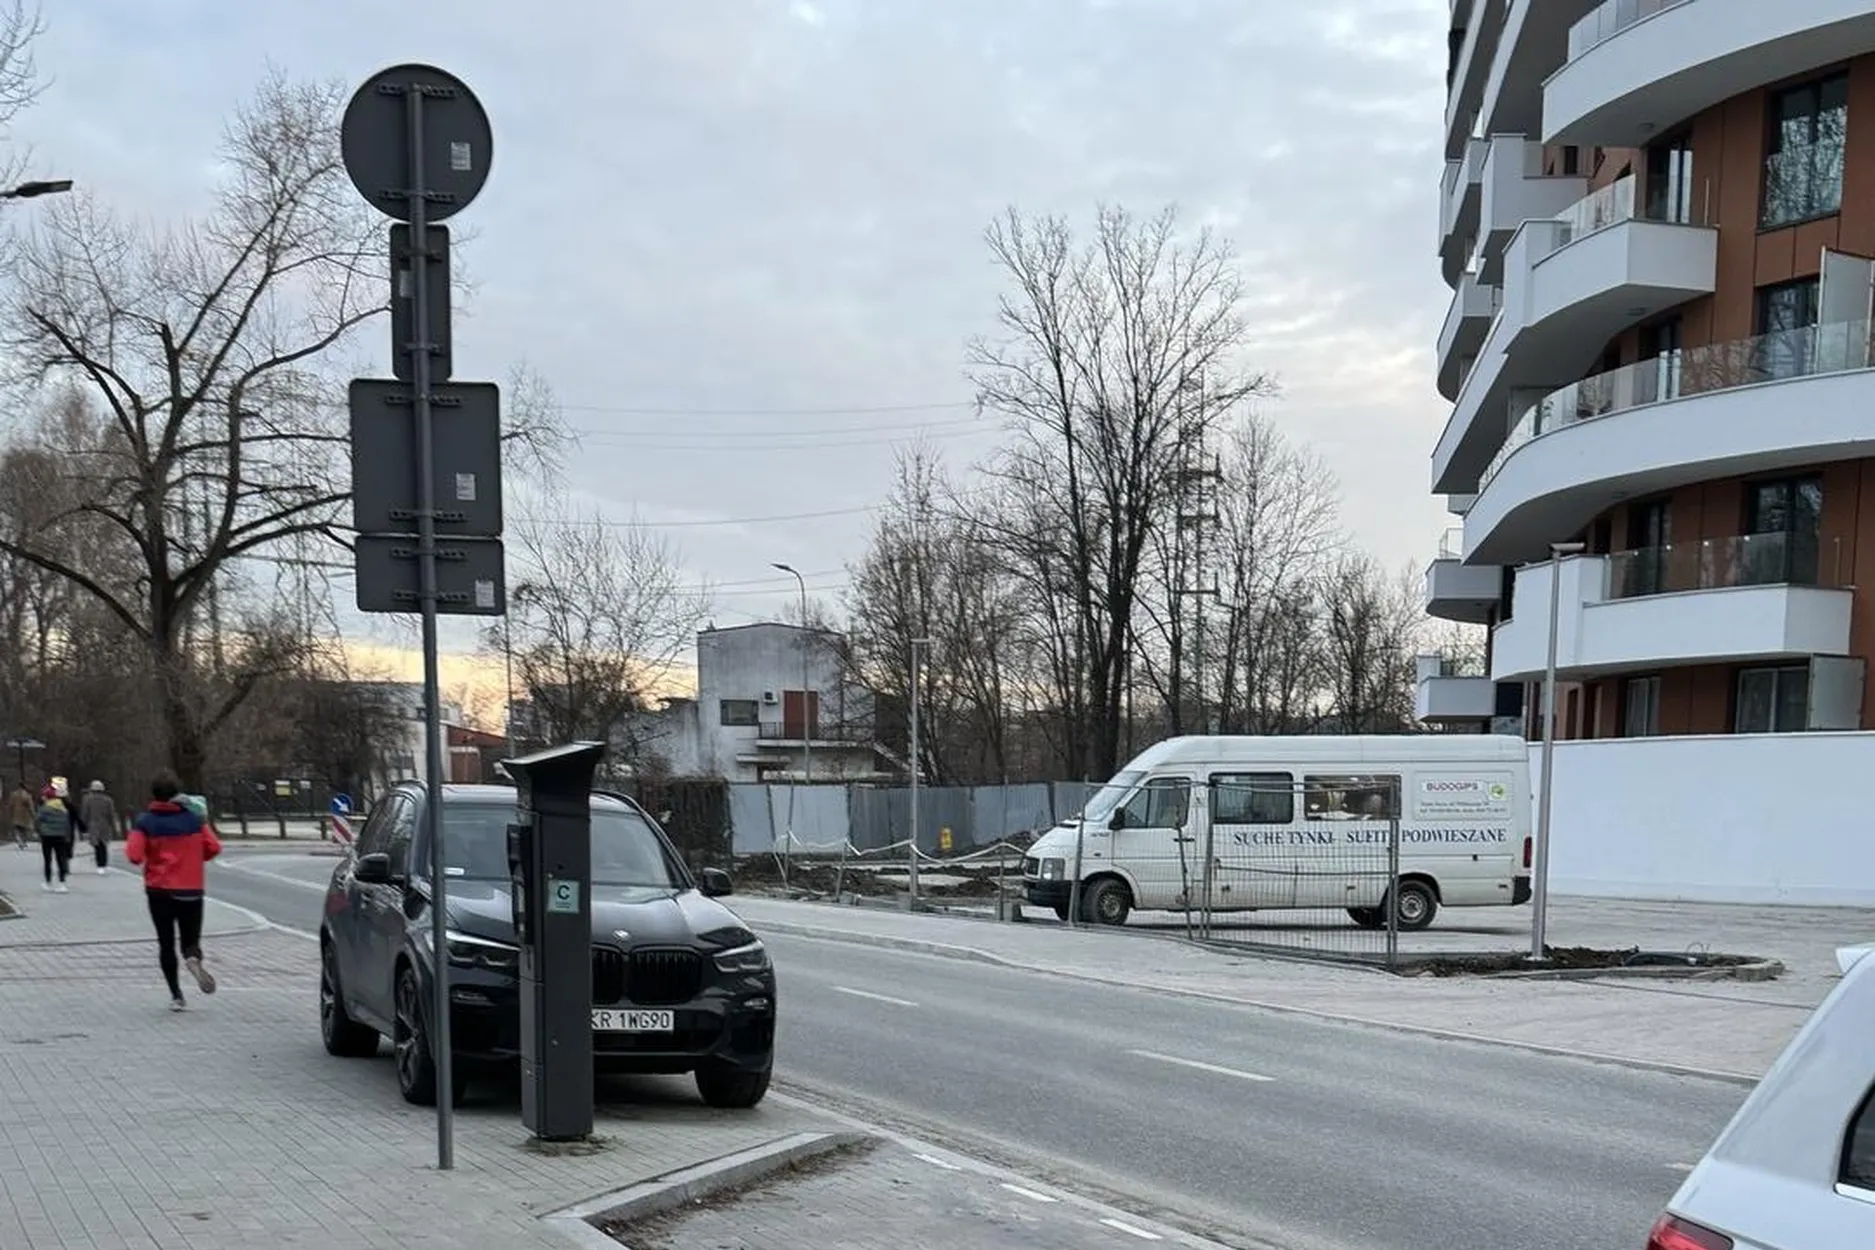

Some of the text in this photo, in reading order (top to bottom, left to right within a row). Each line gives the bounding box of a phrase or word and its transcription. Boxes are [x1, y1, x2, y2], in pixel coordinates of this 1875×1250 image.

[1234, 831, 1284, 845] SUCHE
[1346, 829, 1397, 843] SUFIT
[1401, 828, 1507, 842] PODWIESZANE
[557, 885, 570, 900] C
[620, 1012, 669, 1028] 1WG90
